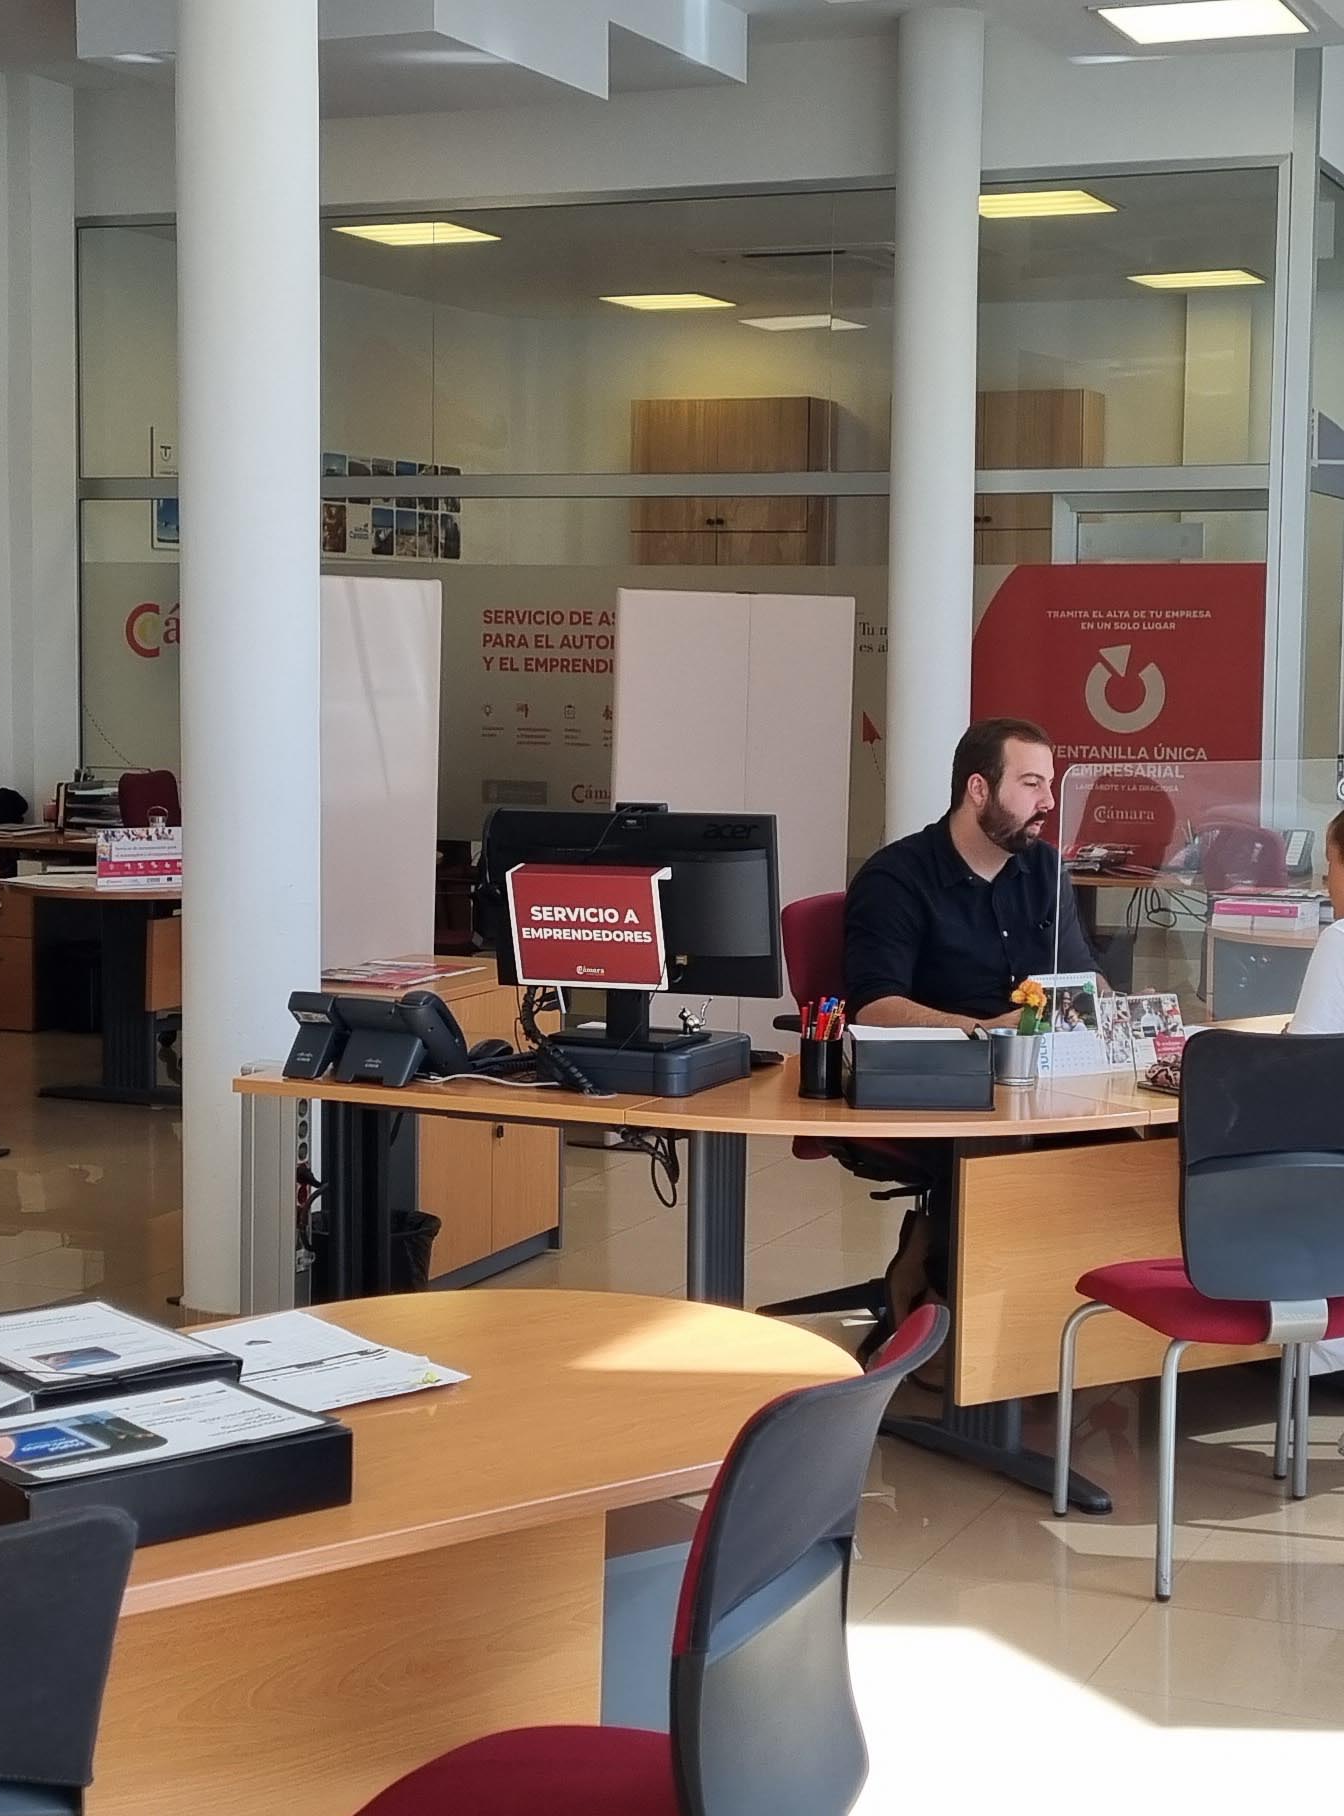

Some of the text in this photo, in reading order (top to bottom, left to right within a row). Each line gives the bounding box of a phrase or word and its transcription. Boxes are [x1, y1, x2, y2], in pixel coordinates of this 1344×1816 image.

[483, 609, 564, 626] SERVICIO
[569, 610, 593, 626] DE
[1046, 609, 1212, 619] TRAMITA EL ALTA DE TU EMPRESA
[1080, 621, 1176, 630] EN UN SOLO LUGAR
[482, 633, 614, 650] PARA EL AUTO
[482, 656, 614, 674] Y EL EMPREND
[1154, 742, 1208, 760] ÚNICA
[1071, 763, 1184, 779] EMPRESARIAL
[1094, 805, 1155, 824] Cámara
[703, 823, 761, 841] acer
[530, 906, 640, 924] SERVICIO A
[521, 927, 653, 943] EMPRENDEDORES
